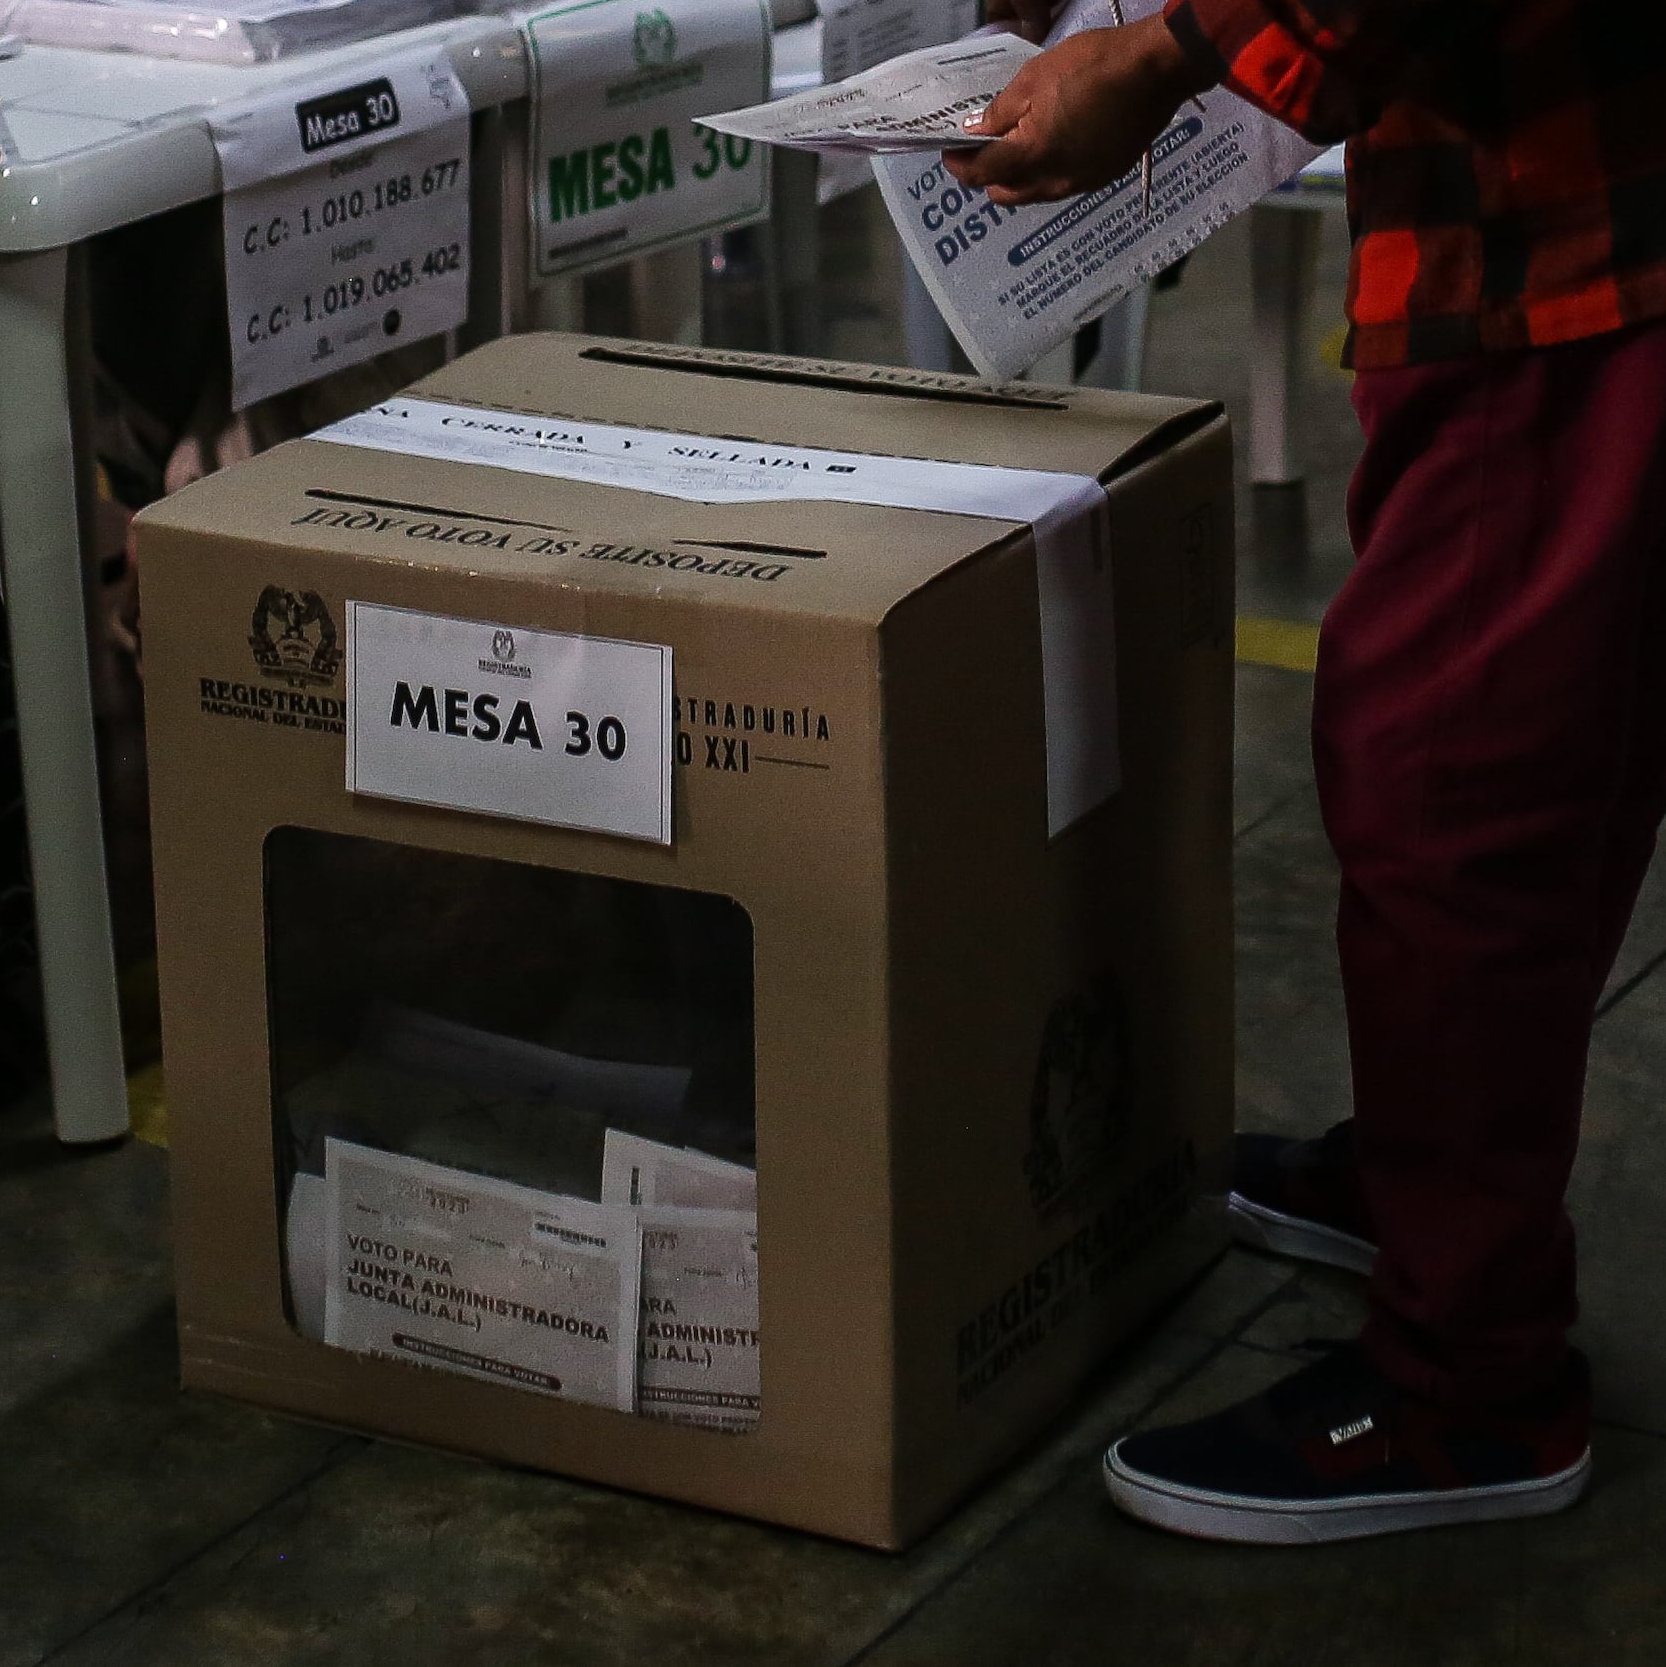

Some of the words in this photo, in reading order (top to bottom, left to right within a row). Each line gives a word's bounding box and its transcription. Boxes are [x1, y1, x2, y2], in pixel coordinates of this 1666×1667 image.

[304, 111, 361, 146] Mesa
[364, 92, 395, 127] 30
[302, 158, 461, 234] 1.010.188.677
[548, 127, 676, 223] MESA
[692, 122, 751, 180] 30
[906, 159, 945, 200] VOT
[935, 200, 1018, 266] DIST
[303, 242, 461, 322] 1.019.065.402
[440, 415, 585, 444] CERRADA
[667, 444, 811, 473] SELLADA
[404, 521, 514, 551] VOTO
[515, 535, 581, 558] SU
[582, 541, 793, 583] DEPOSITE
[389, 681, 544, 751] MESA
[565, 710, 626, 762] 30
[673, 696, 830, 742] STRADURÍA
[704, 734, 750, 774] XXI
[347, 1234, 398, 1262] VOTO
[403, 1249, 453, 1278] PARA
[348, 1259, 416, 1291] JUNTA
[421, 1280, 610, 1343] ADMINISTRADORA
